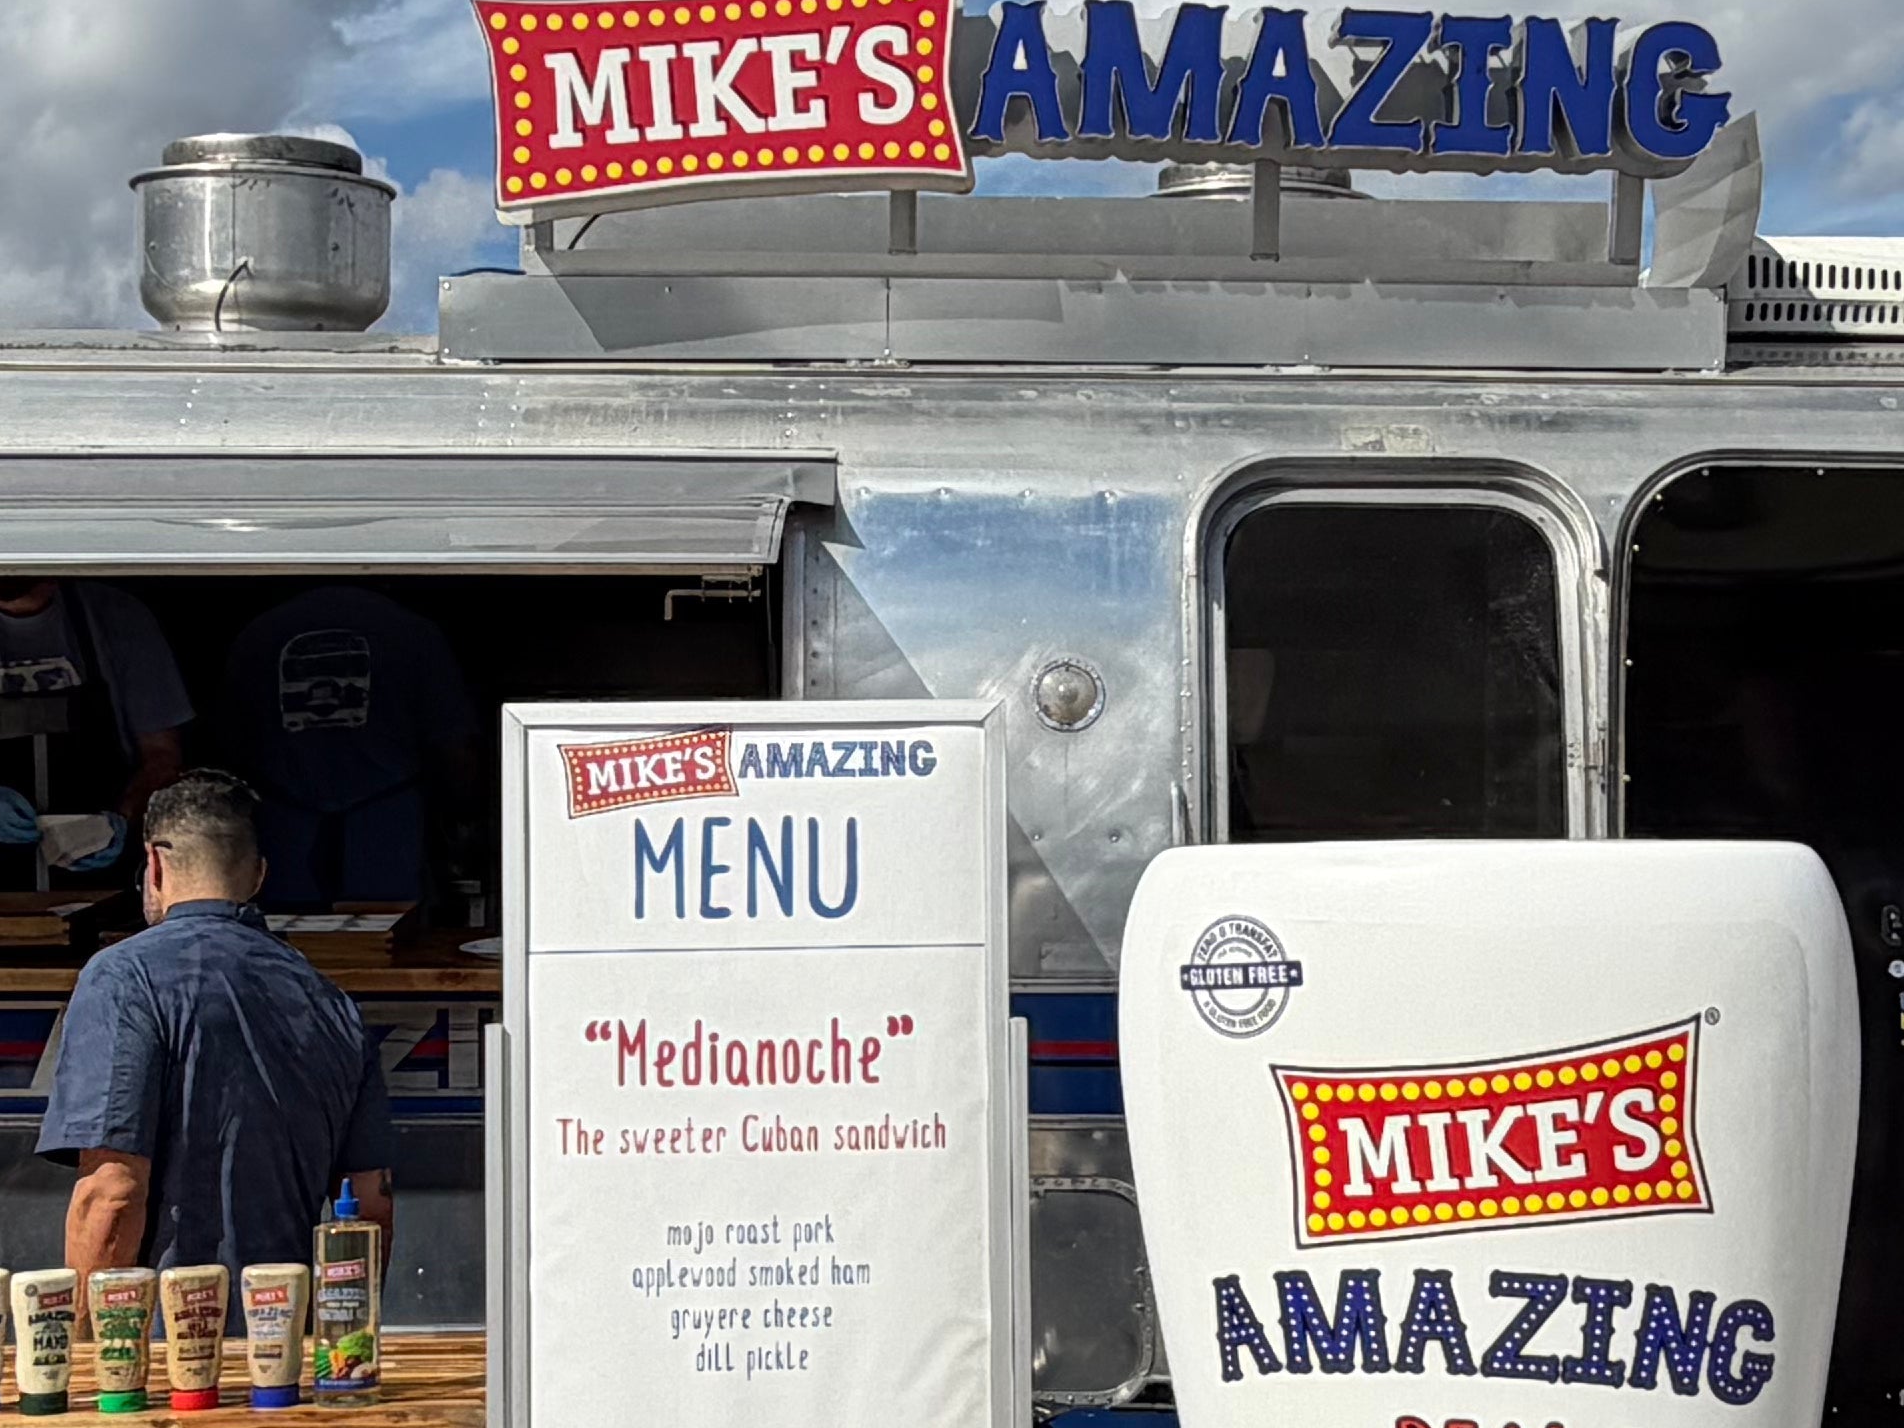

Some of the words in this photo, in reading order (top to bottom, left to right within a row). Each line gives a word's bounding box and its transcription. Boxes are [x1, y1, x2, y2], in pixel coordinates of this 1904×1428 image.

[543, 25, 915, 150] MIKE'S
[585, 745, 718, 797] MIKE'S
[737, 739, 938, 779] AMAZING
[633, 814, 859, 919] MENU
[1189, 967, 1244, 986] GLUTEN
[1247, 964, 1289, 985] FREE
[556, 1117, 604, 1155] The
[619, 1117, 727, 1155] sweeter
[741, 1113, 819, 1153] Cuban
[833, 1113, 946, 1152] sandwich
[1338, 1087, 1665, 1198] MIKE'S
[667, 1220, 714, 1254] mojo
[725, 1215, 781, 1246] roast
[793, 1214, 835, 1251] pork
[632, 1258, 736, 1297] applewood
[748, 1256, 819, 1287] smoked
[831, 1256, 871, 1285] ham
[670, 1306, 751, 1339] gruyere
[763, 1299, 833, 1329] cheese
[1213, 1269, 1775, 1405] AMAZING
[695, 1342, 734, 1372] dill
[746, 1340, 808, 1380] pickle
